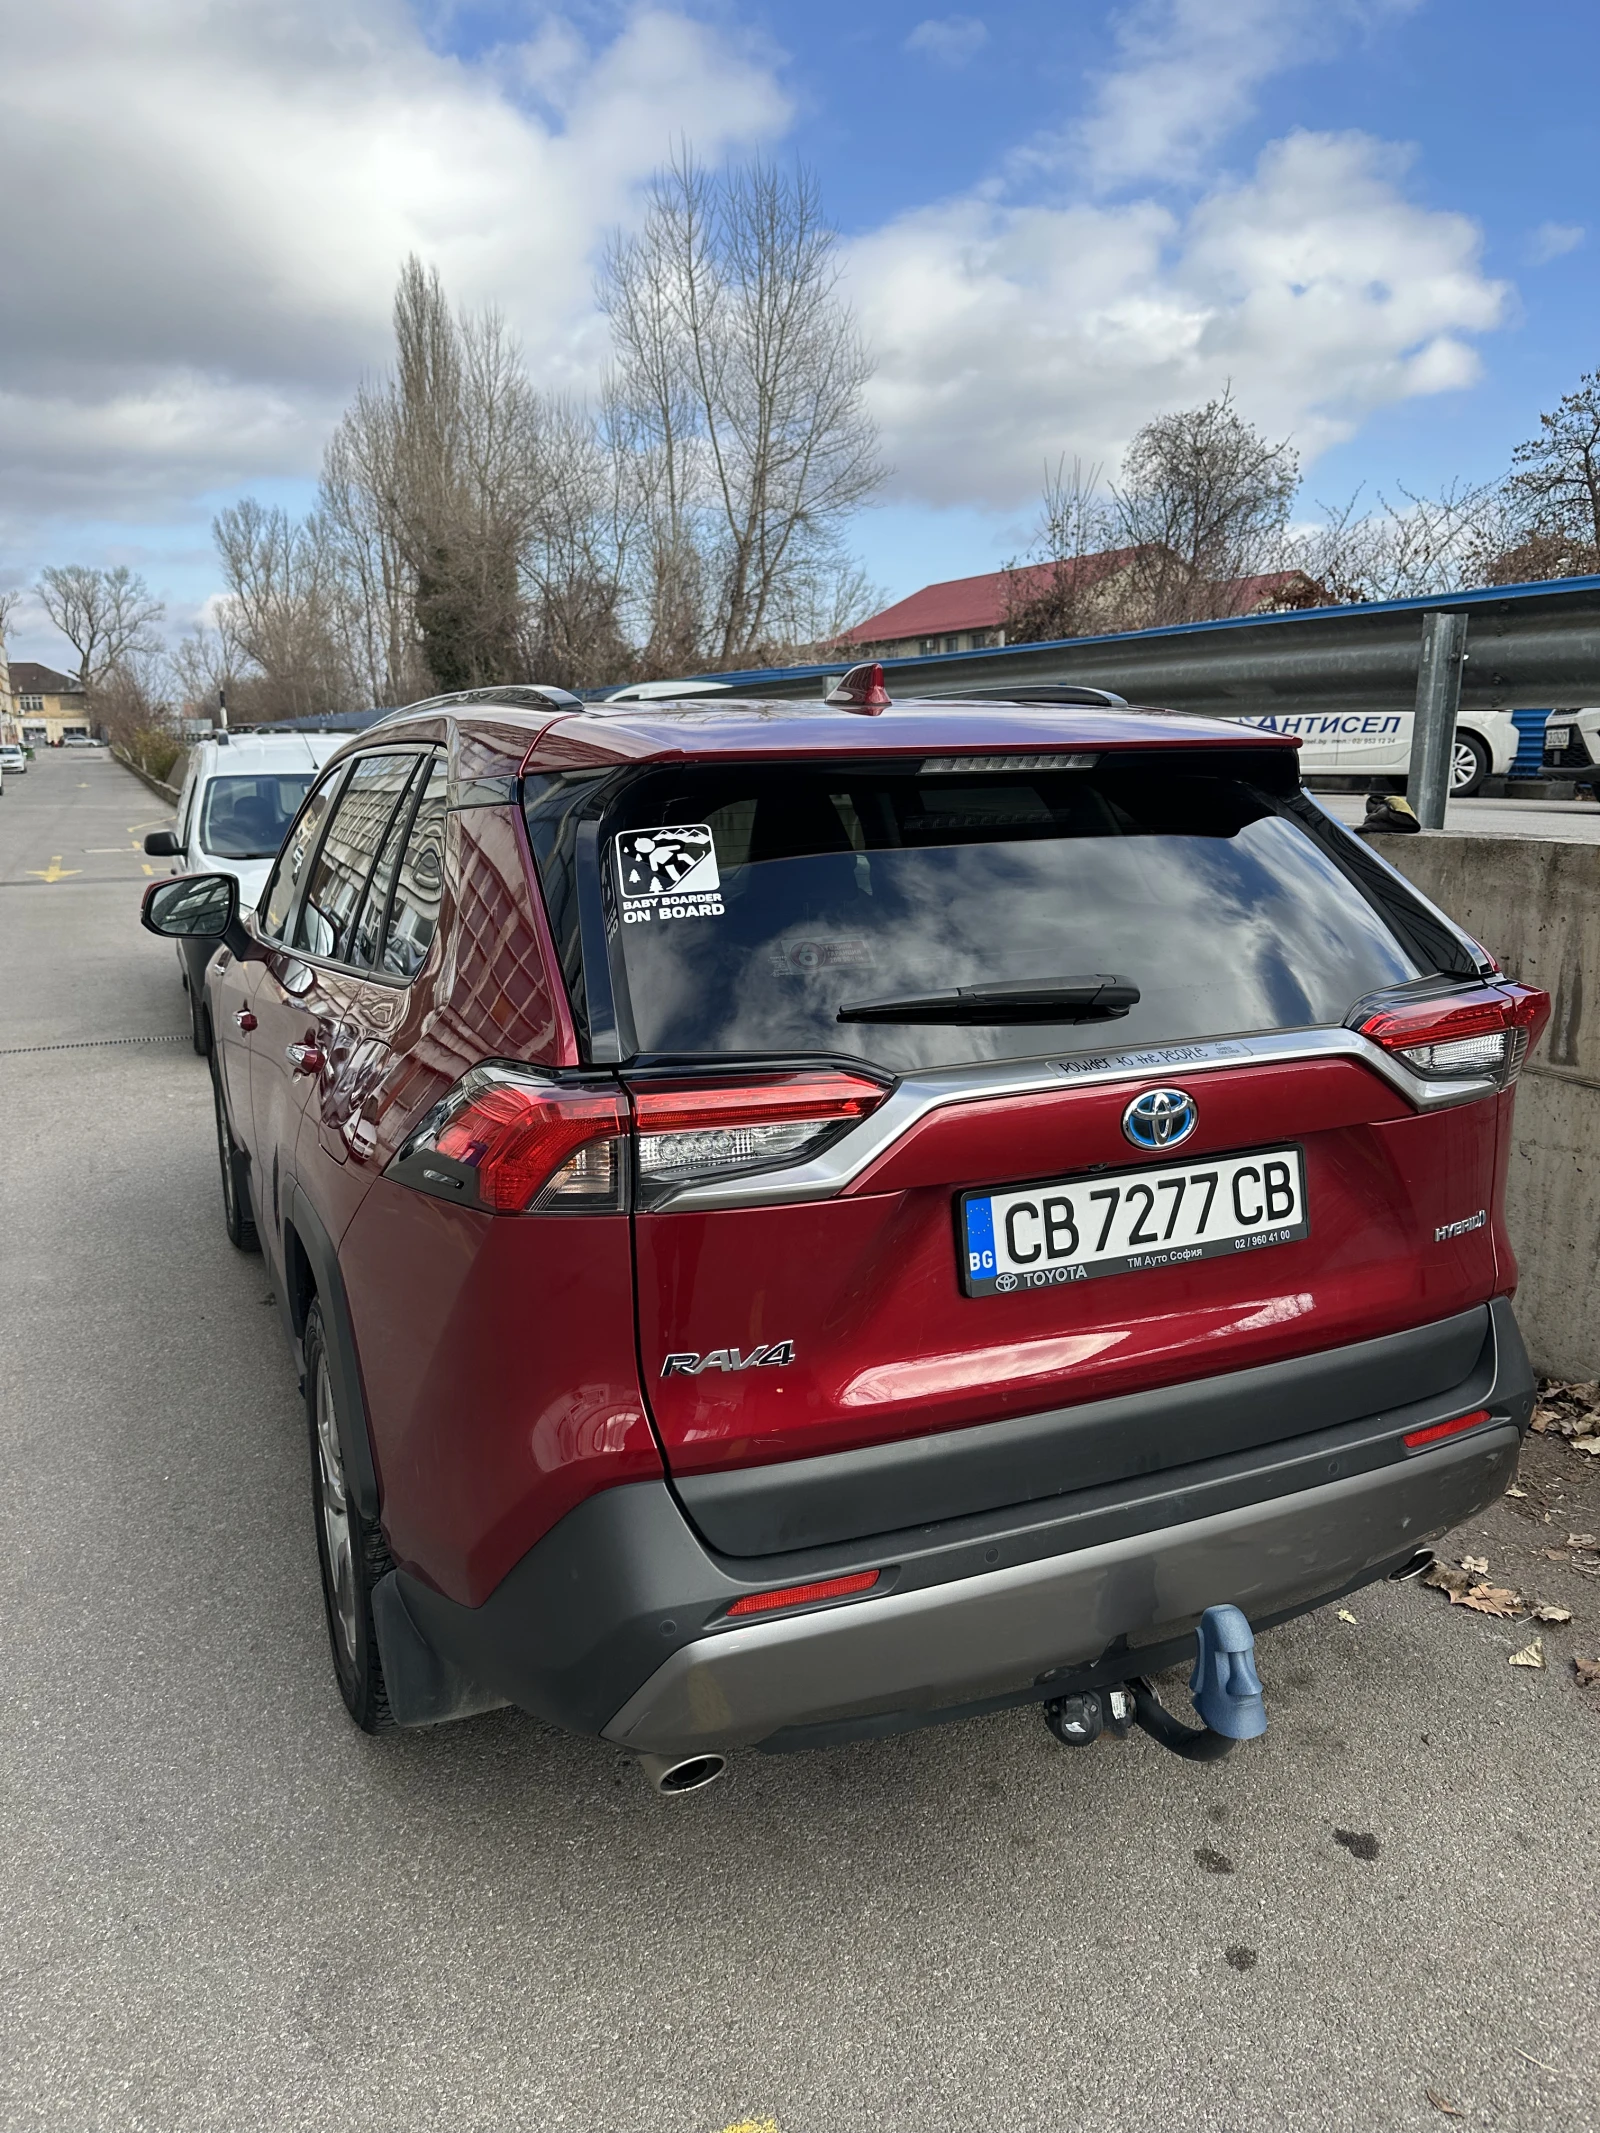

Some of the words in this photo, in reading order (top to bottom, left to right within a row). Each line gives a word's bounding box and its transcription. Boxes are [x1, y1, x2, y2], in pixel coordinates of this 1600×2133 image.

[623, 898, 658, 910] BABY
[661, 893, 722, 905] BOARDER
[623, 910, 651, 924] ON
[659, 903, 725, 920] BOARD
[1116, 1056, 1134, 1067] to
[1135, 1053, 1160, 1065] the
[1004, 1196, 1080, 1265] CB
[1089, 1171, 1219, 1252] 7277
[1231, 1160, 1295, 1226] CB
[1434, 1209, 1487, 1242] HYBRID
[1234, 1239, 1246, 1249] 02
[1251, 1235, 1267, 1246] 960
[1268, 1232, 1278, 1243] 41
[1280, 1230, 1291, 1240] 00
[969, 1250, 994, 1272] BG
[1144, 1254, 1167, 1267] Ауто
[1170, 1248, 1203, 1261] София
[1023, 1264, 1088, 1287] TOYOTA
[660, 1339, 796, 1378] RAV4
